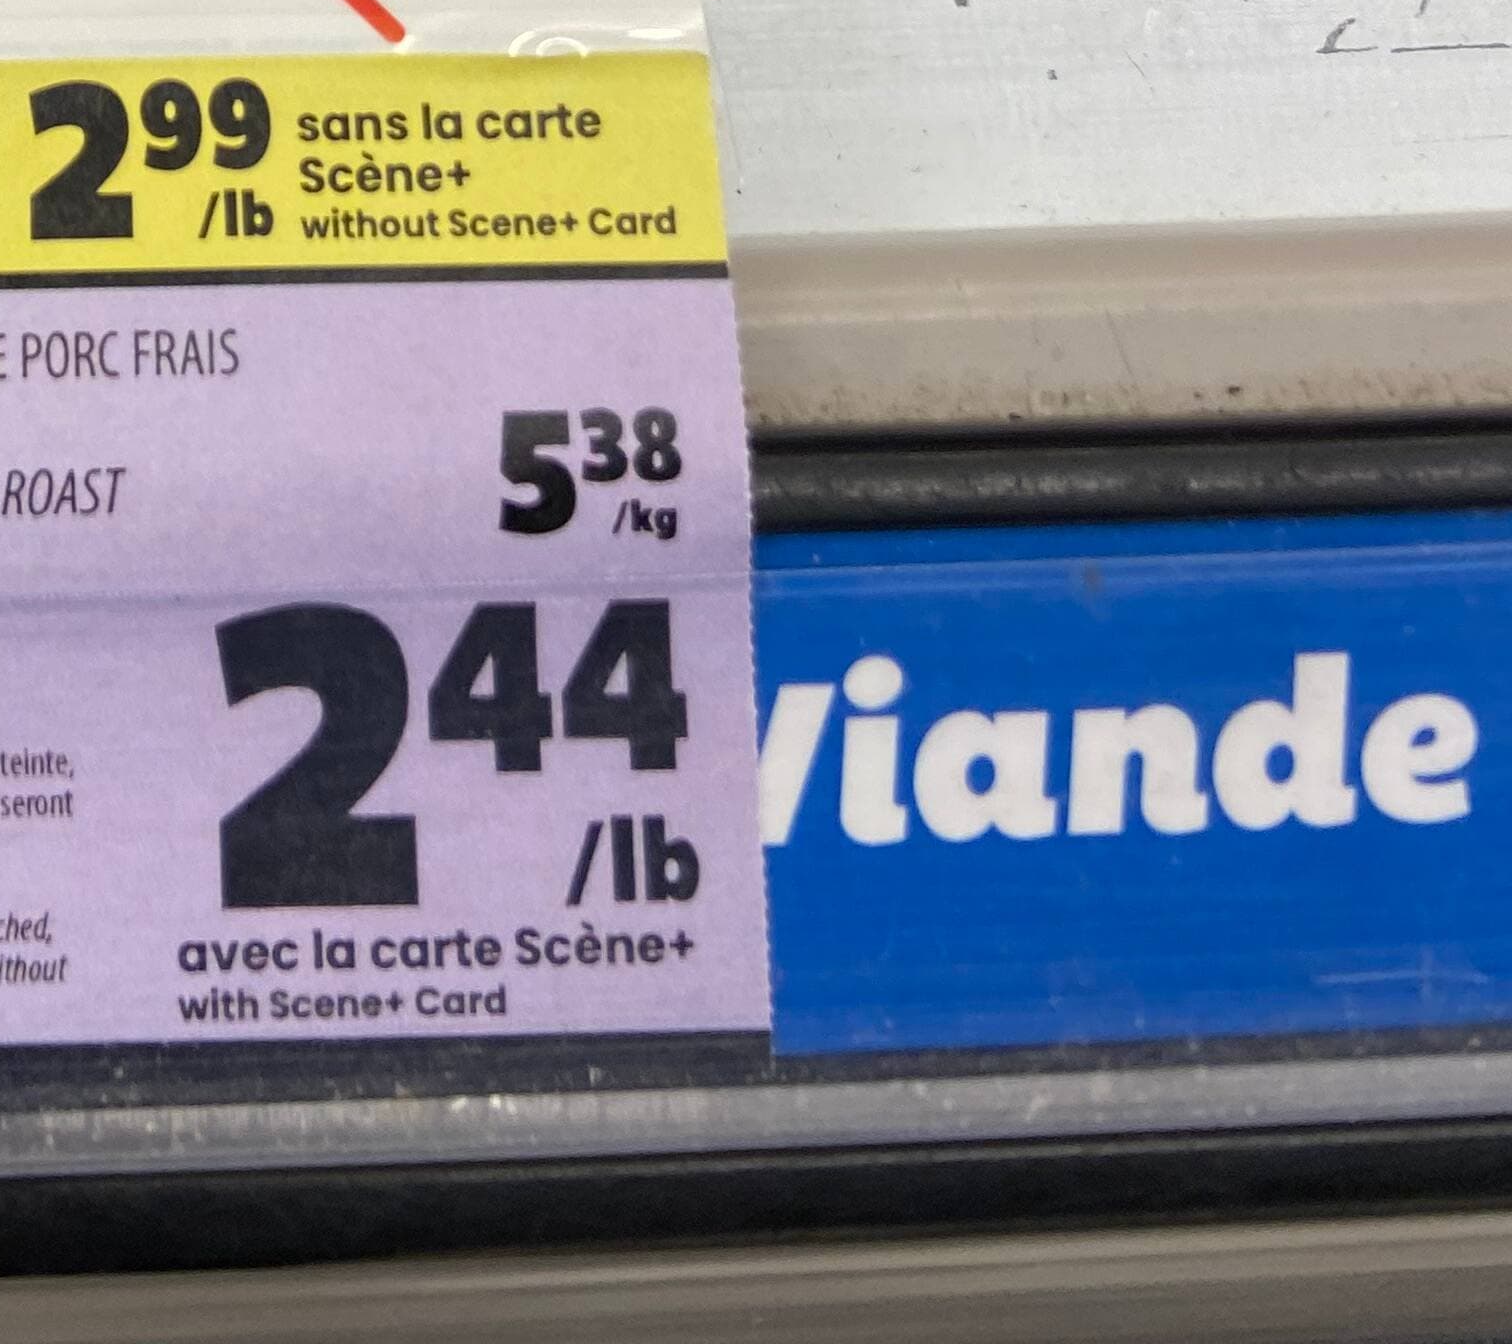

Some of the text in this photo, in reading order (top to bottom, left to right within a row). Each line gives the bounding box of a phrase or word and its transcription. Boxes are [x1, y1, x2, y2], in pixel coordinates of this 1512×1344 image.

[297, 102, 602, 144] sans la carte
[299, 152, 472, 196] Scène+
[199, 187, 274, 239] /lb
[301, 204, 677, 240] without Scene+ Card
[22, 329, 120, 380] PORC
[133, 328, 241, 378] FRAIS
[1, 467, 127, 517] ROAST
[611, 498, 678, 541] /kg
[0, 788, 73, 817] seront
[565, 814, 701, 907] /lb
[177, 921, 695, 972] avec la carte Scène+
[178, 984, 507, 1021] with Scene+ Card
